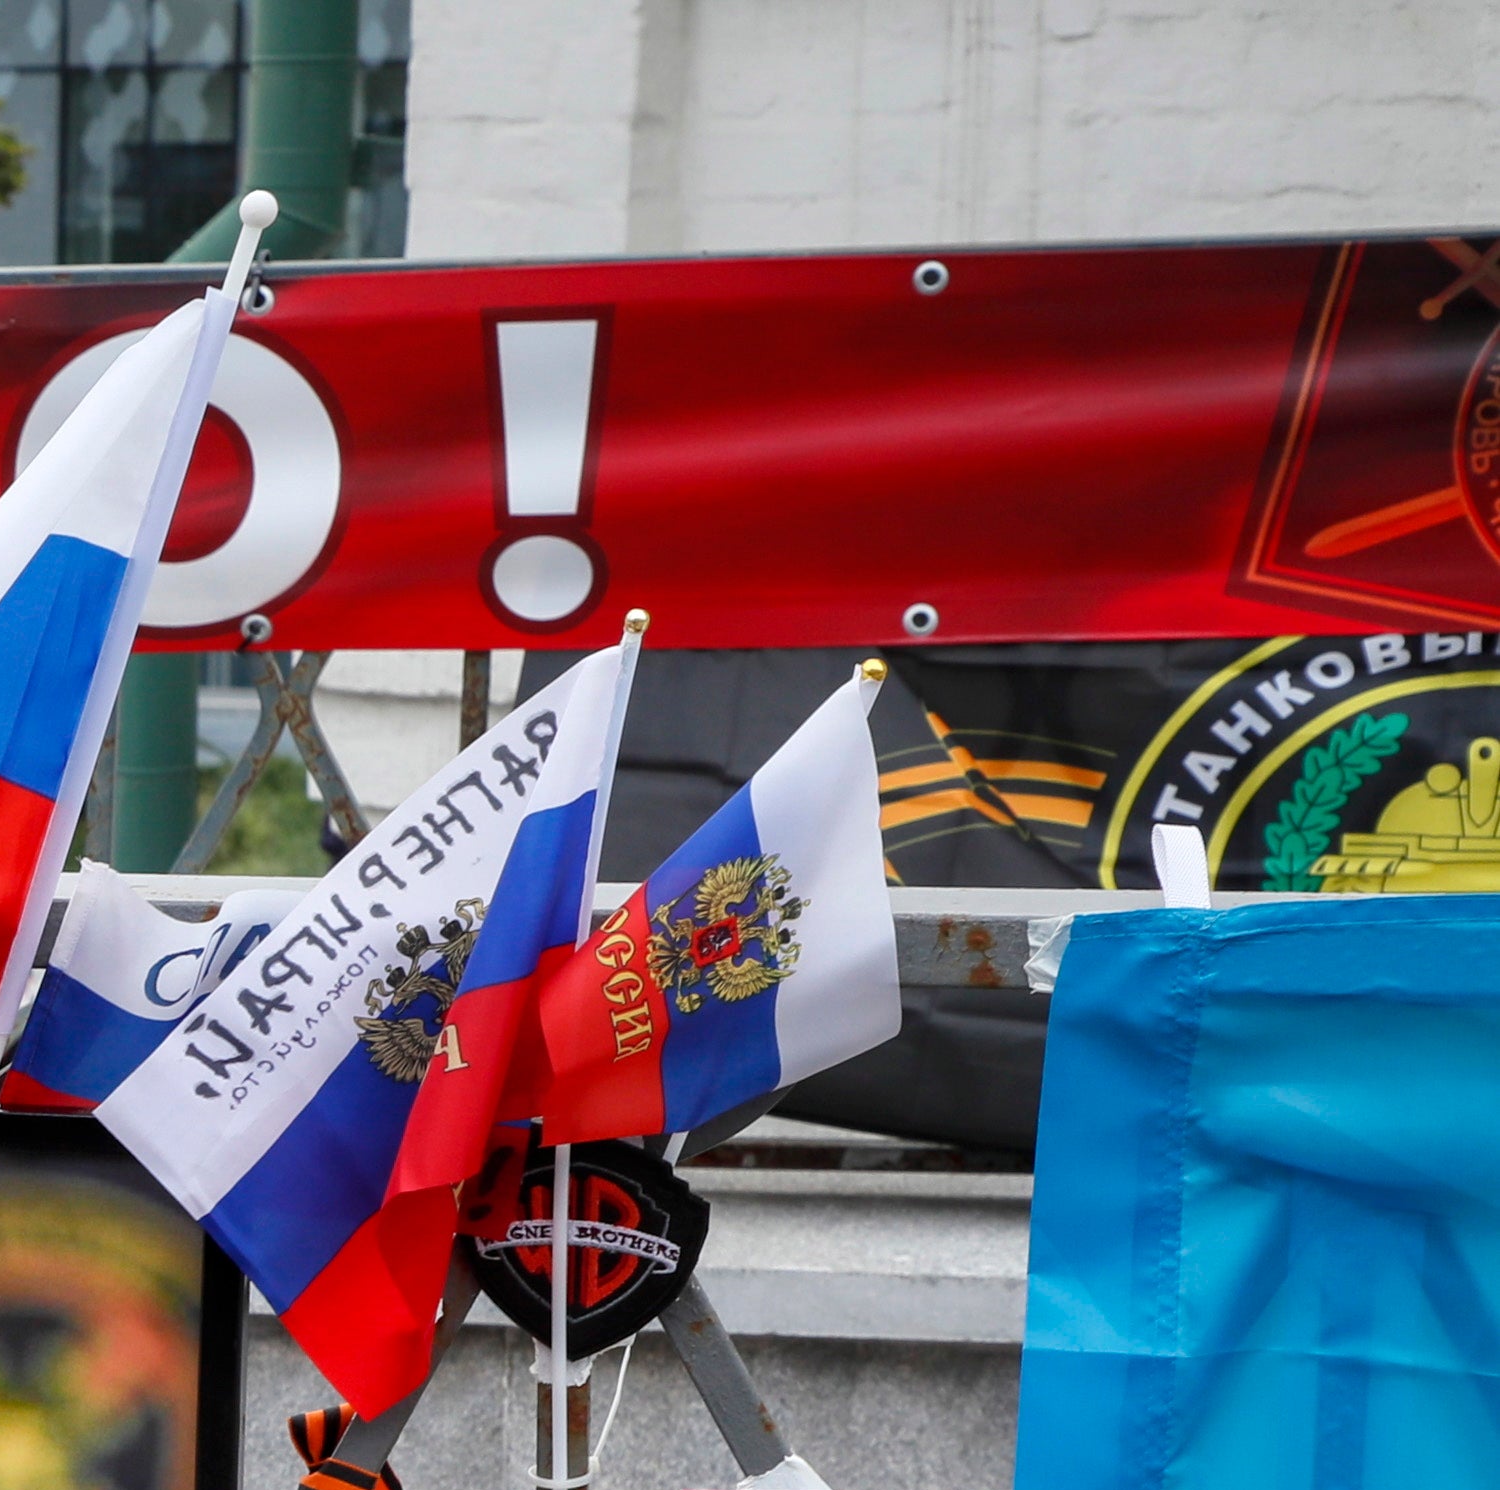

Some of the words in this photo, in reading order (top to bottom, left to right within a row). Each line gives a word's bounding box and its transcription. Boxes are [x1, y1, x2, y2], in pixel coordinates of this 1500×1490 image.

[1153, 632, 1500, 820] ТАНКОВЫ
[144, 923, 270, 1007] СЛА
[595, 907, 652, 1062] ОССИЯ
[575, 1226, 680, 1262] BROTHERS
